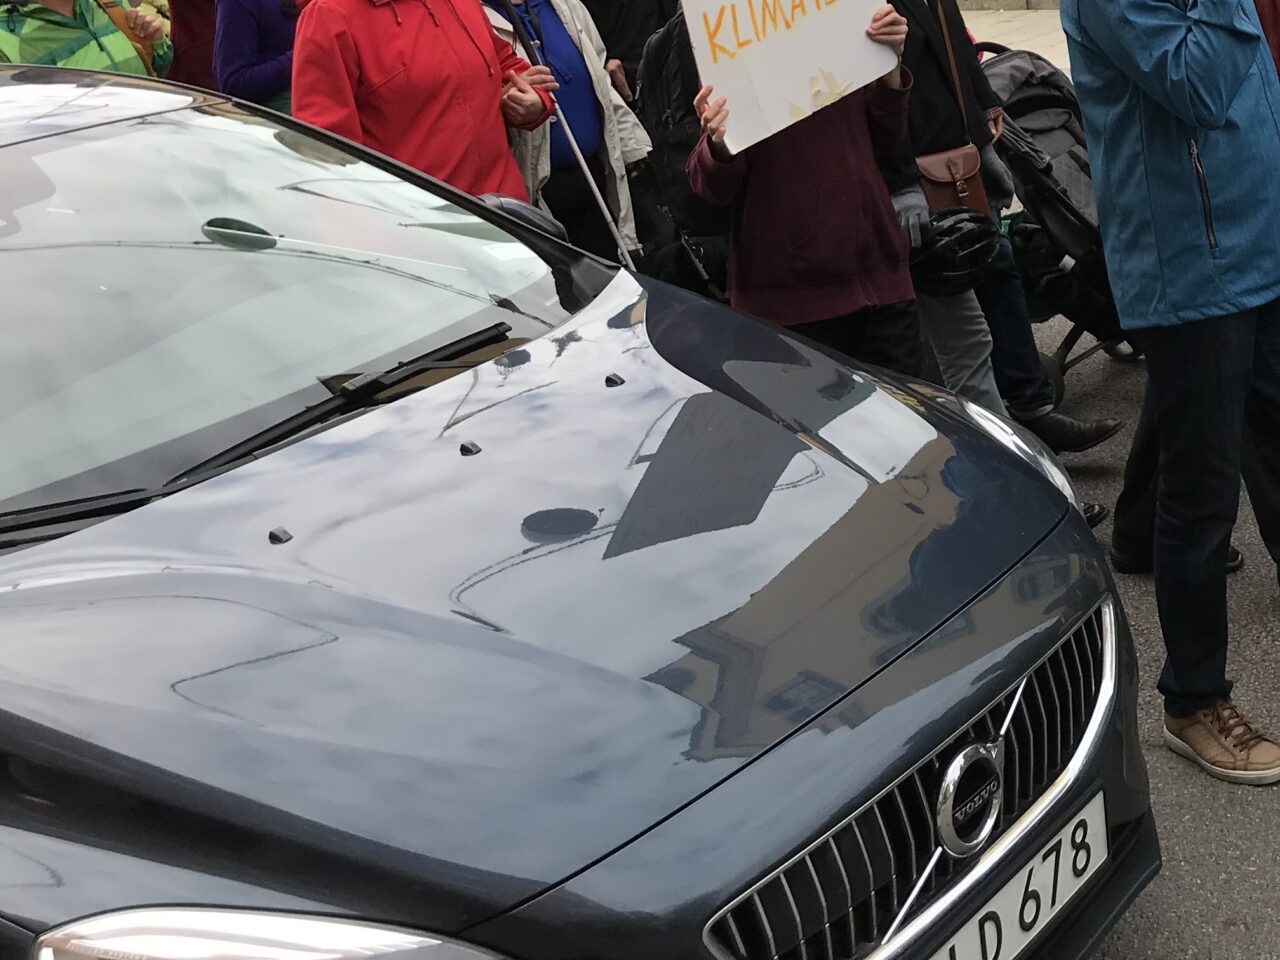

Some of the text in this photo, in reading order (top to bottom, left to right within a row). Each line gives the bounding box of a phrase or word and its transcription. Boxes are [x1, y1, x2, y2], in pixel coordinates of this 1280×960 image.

[955, 781, 998, 820] VOLVO
[949, 818, 1091, 960] D 678
